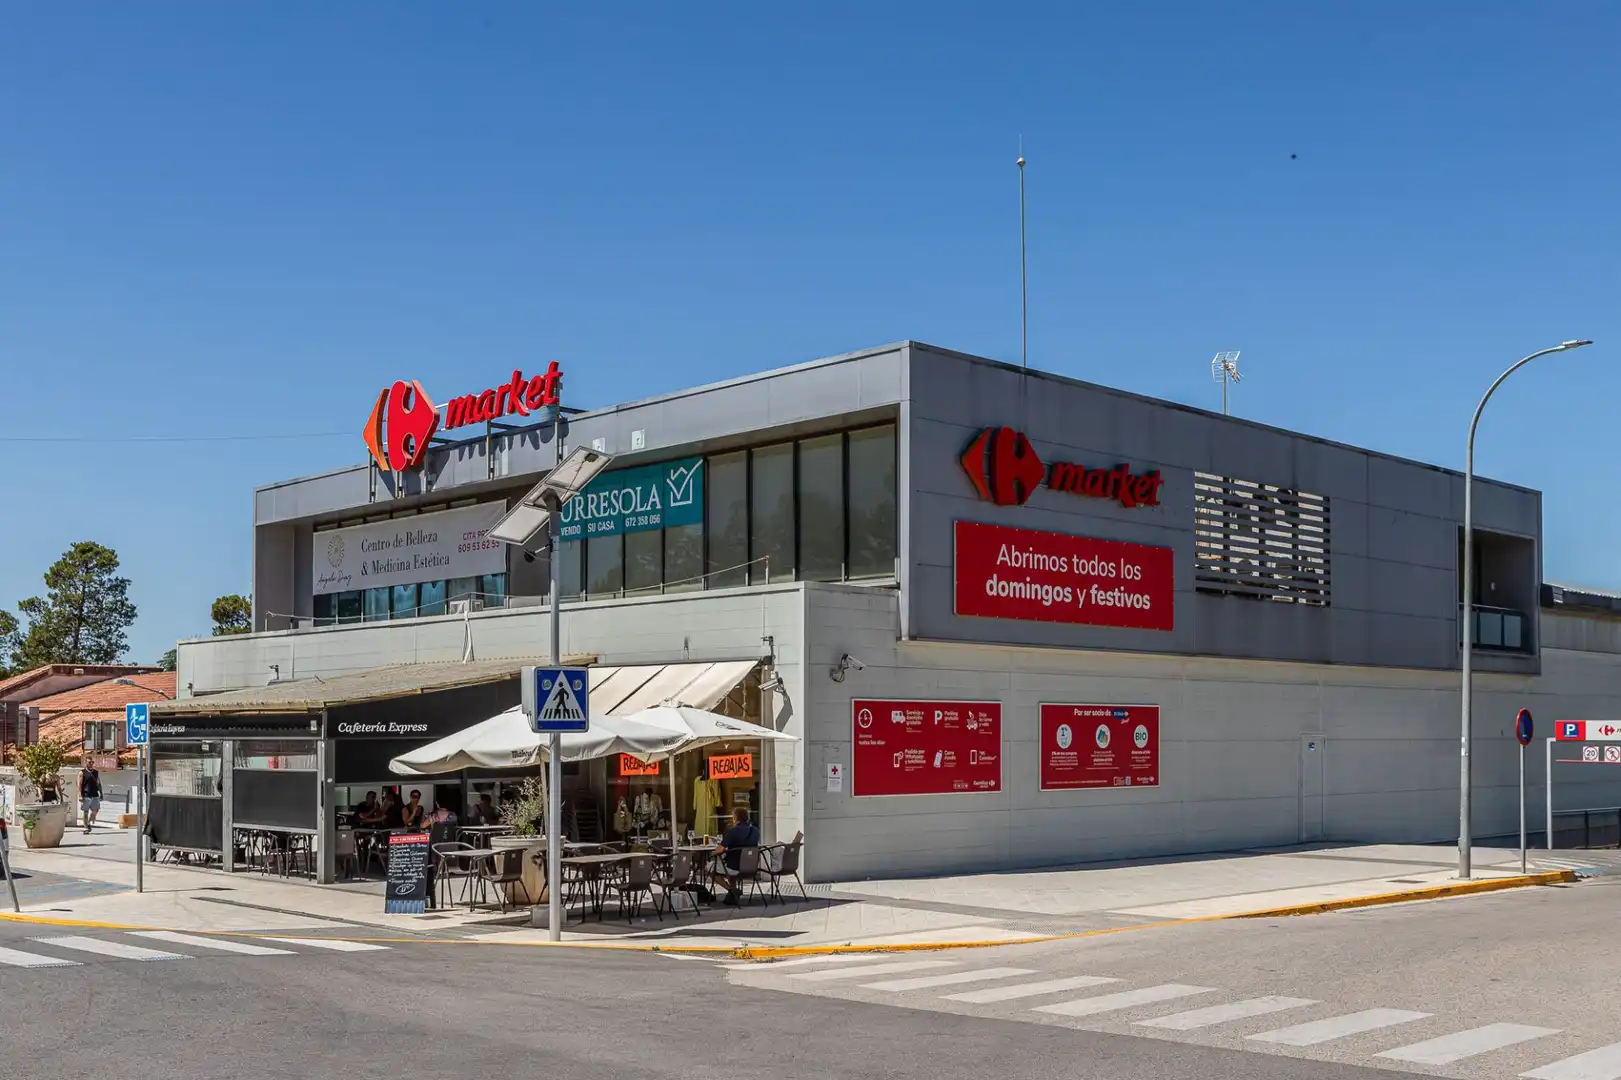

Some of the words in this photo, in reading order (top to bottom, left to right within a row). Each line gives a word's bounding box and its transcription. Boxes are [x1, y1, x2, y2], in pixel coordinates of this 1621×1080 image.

[445, 360, 563, 430] market
[1048, 461, 1164, 508] market
[560, 525, 581, 536] VENDO
[587, 522, 597, 533] SU
[598, 520, 615, 531] CASA
[625, 517, 636, 527] 672
[637, 516, 648, 526] 358
[649, 514, 661, 524] 056
[361, 537, 391, 553] Centro
[393, 534, 403, 548] de
[406, 529, 438, 546] Belleza
[462, 531, 476, 541] CITA
[458, 543, 471, 553] 609
[361, 563, 369, 576] &
[371, 559, 411, 575] Medicina
[413, 551, 450, 570] Estética
[996, 543, 1068, 573] Abrimos
[1072, 553, 1116, 578] todos
[1120, 557, 1142, 581] los
[985, 573, 1072, 607] domingos
[1076, 587, 1087, 608] y
[1090, 583, 1151, 610] festivos
[1073, 708, 1083, 716] Por
[338, 721, 386, 734] Cafetería
[387, 721, 428, 734] Express
[1135, 732, 1147, 741] BIO
[1566, 723, 1576, 736] P
[712, 757, 750, 774] REBAJAS
